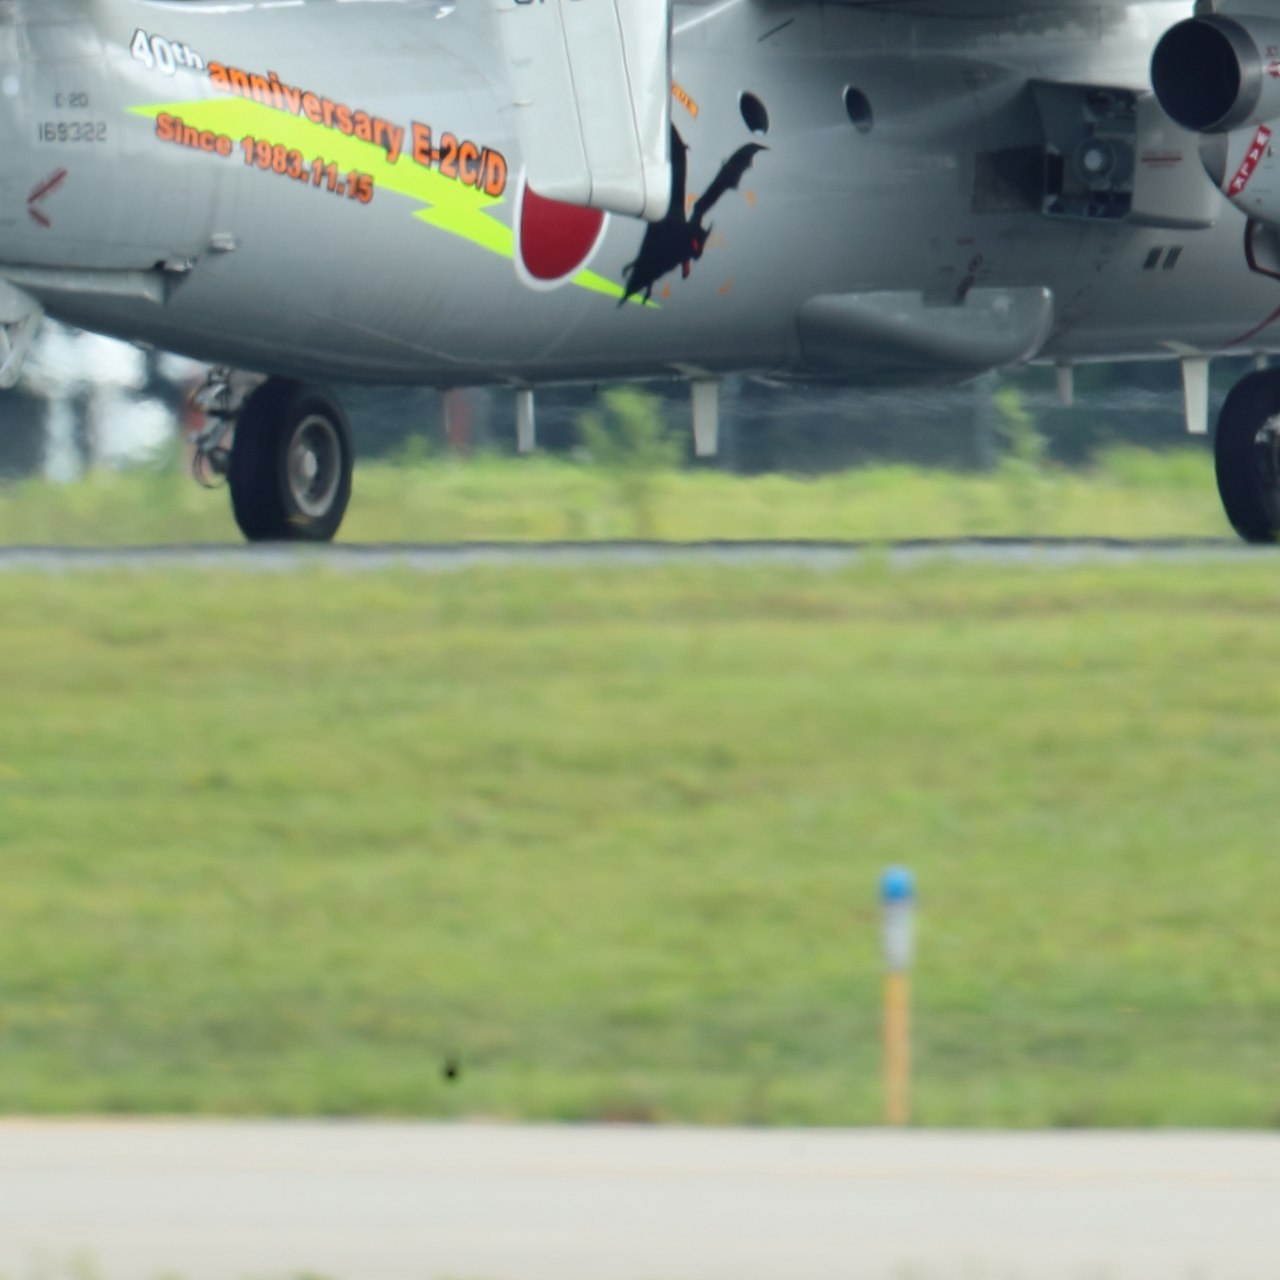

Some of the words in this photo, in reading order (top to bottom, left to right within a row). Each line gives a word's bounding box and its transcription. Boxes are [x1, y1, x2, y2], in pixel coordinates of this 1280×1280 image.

[38, 121, 108, 143] 169322
[130, 28, 205, 76] 40th
[207, 61, 404, 164] anniversary
[411, 120, 507, 198] E-2C/D
[155, 112, 233, 157] Since
[241, 135, 375, 204] 1983.11.15
